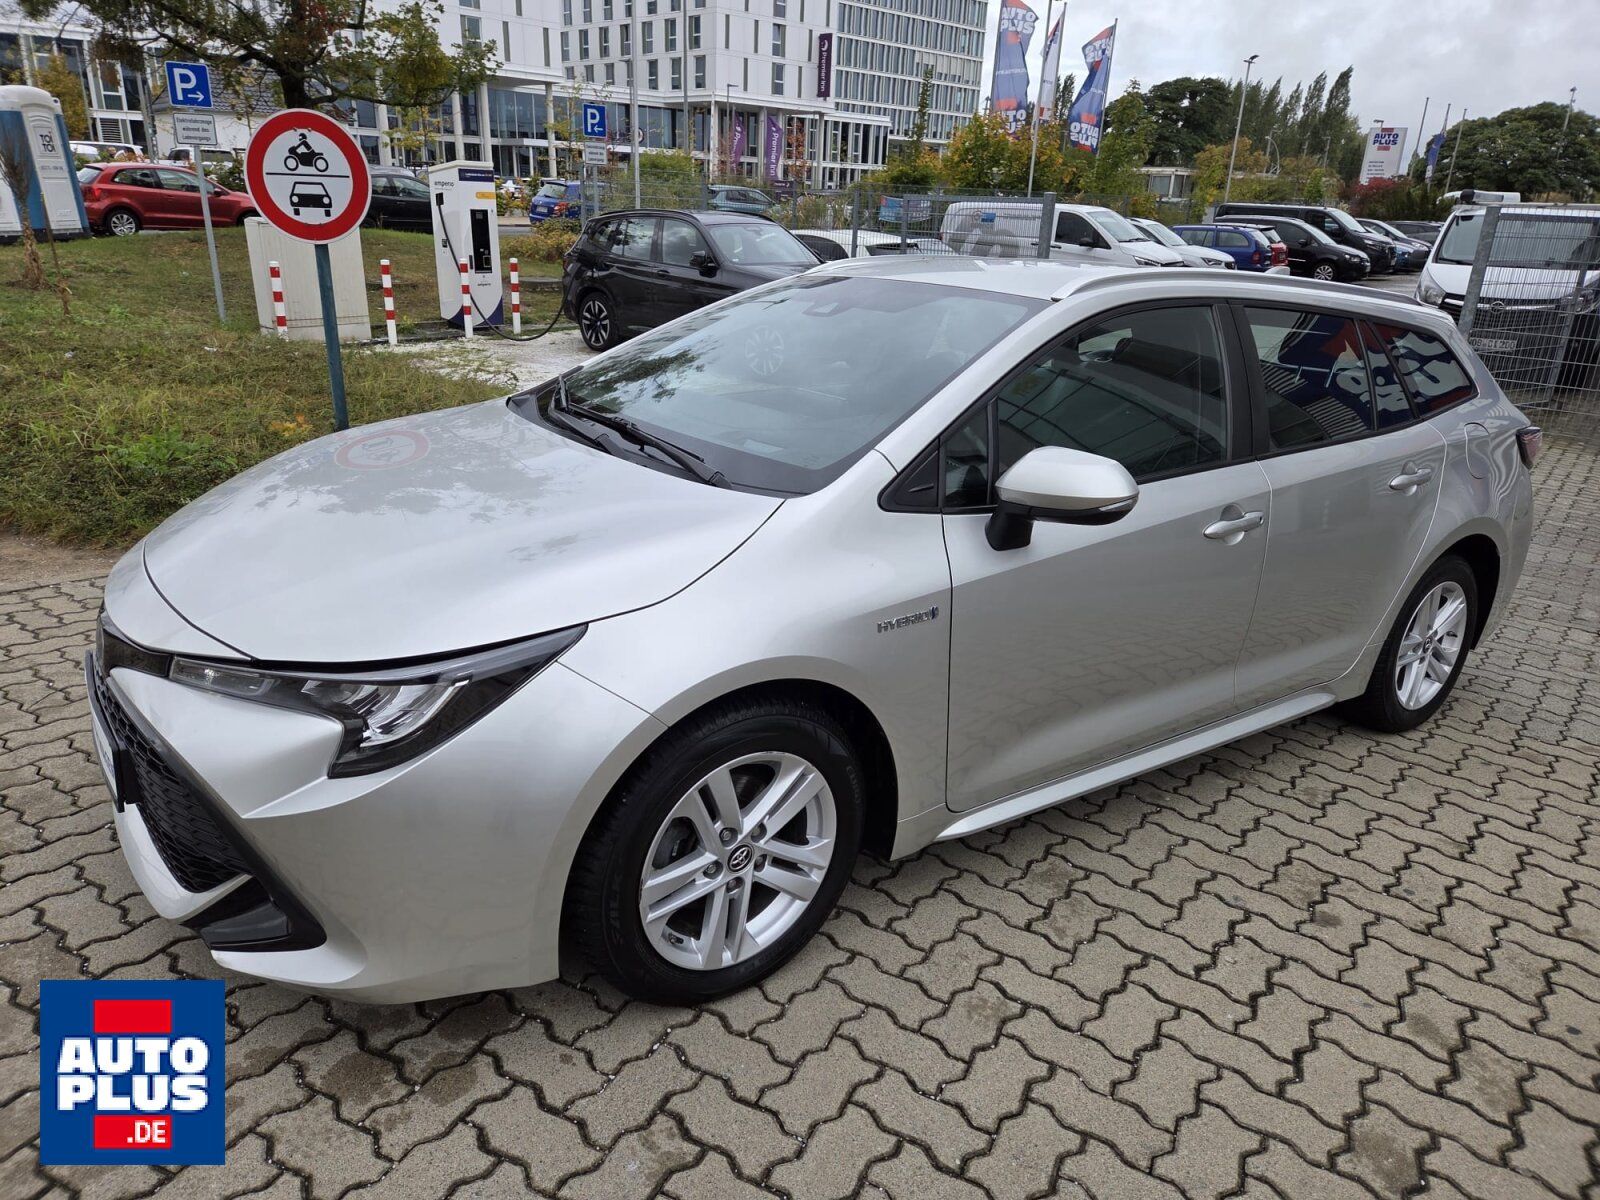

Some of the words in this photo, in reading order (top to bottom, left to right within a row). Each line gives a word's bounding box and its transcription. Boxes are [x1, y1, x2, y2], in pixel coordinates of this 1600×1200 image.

[1001, 7, 1036, 22] AUTO
[1000, 19, 1034, 34] PLUS
[173, 68, 196, 100] P
[587, 108, 600, 133] P
[770, 132, 780, 162] Premier
[769, 164, 777, 176] Inn
[877, 611, 930, 634] HYBRID
